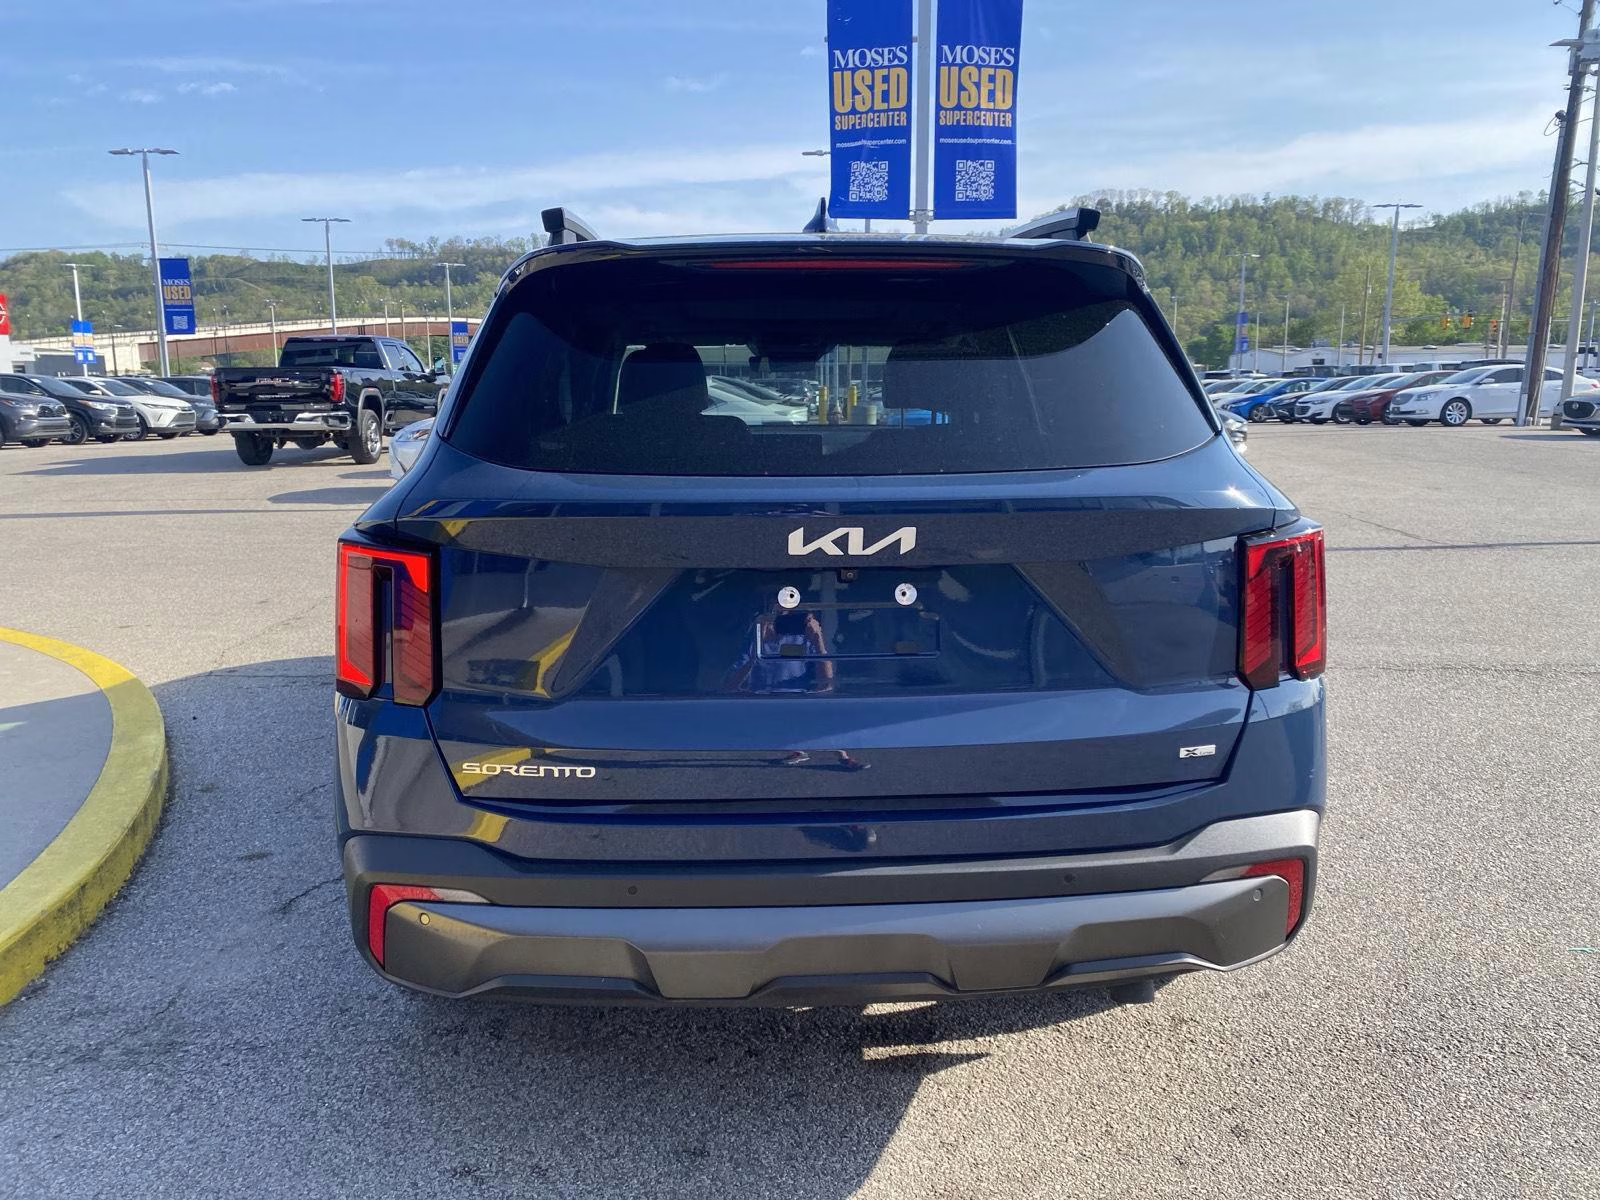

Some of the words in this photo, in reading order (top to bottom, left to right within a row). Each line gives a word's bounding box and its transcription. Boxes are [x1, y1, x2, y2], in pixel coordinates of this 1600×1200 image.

[833, 46, 908, 69] MOSES
[941, 45, 1015, 66] MOSES
[833, 67, 908, 113] USED
[939, 66, 1014, 110] USED
[834, 111, 907, 131] SUPERCENTER
[939, 110, 1012, 128] SUPERCENTER
[939, 137, 1012, 145] mosesusedsupercenter.com
[163, 286, 192, 300] USED
[787, 526, 917, 556] KIA
[462, 762, 596, 778] SORENTO
